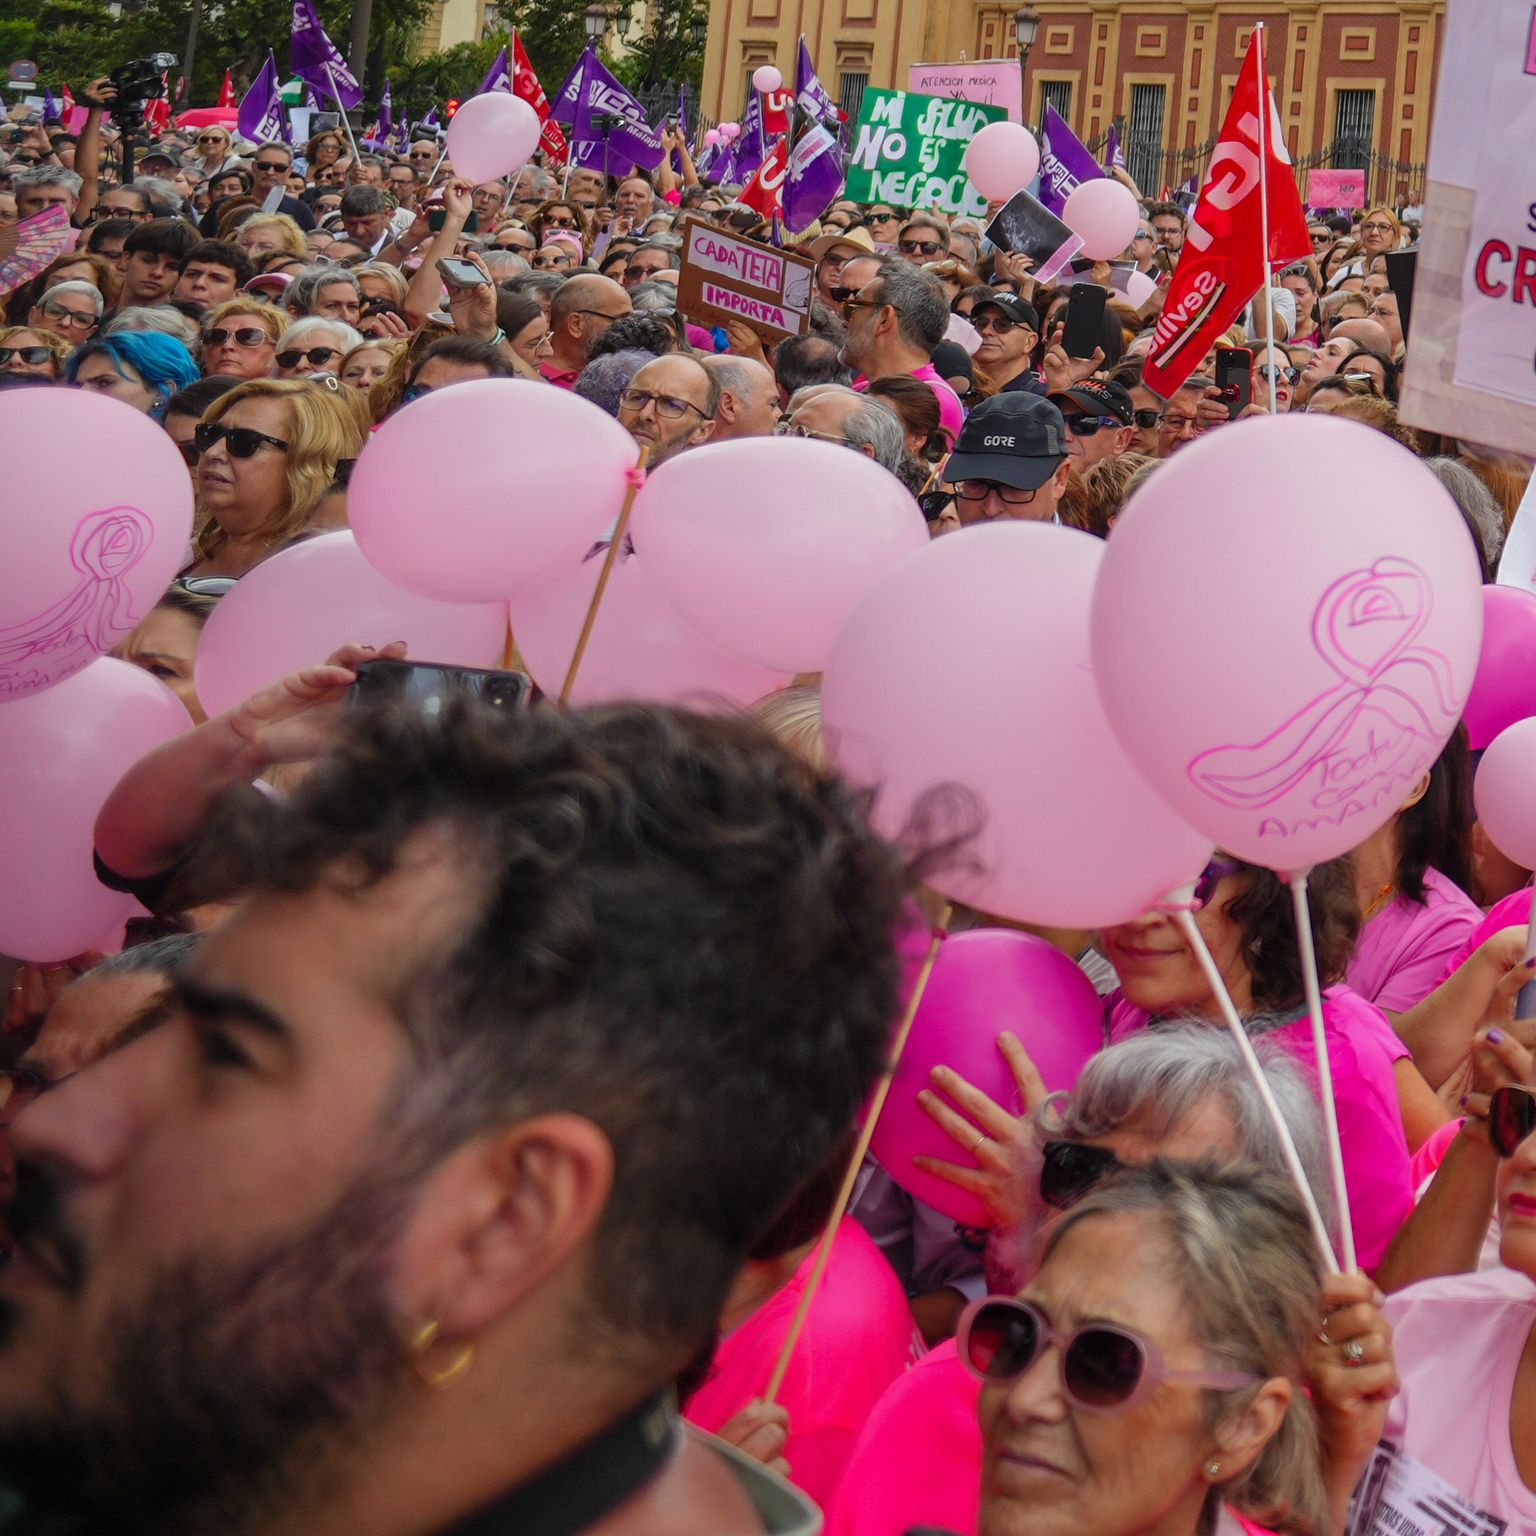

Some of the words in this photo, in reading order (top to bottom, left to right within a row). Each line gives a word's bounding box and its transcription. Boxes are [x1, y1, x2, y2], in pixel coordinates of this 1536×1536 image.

[852, 124, 907, 170] NO
[918, 137, 948, 173] ES
[694, 237, 739, 270] CADA
[735, 245, 782, 291] TETA
[706, 285, 786, 328] IMPORTA
[983, 435, 1016, 448] GORE
